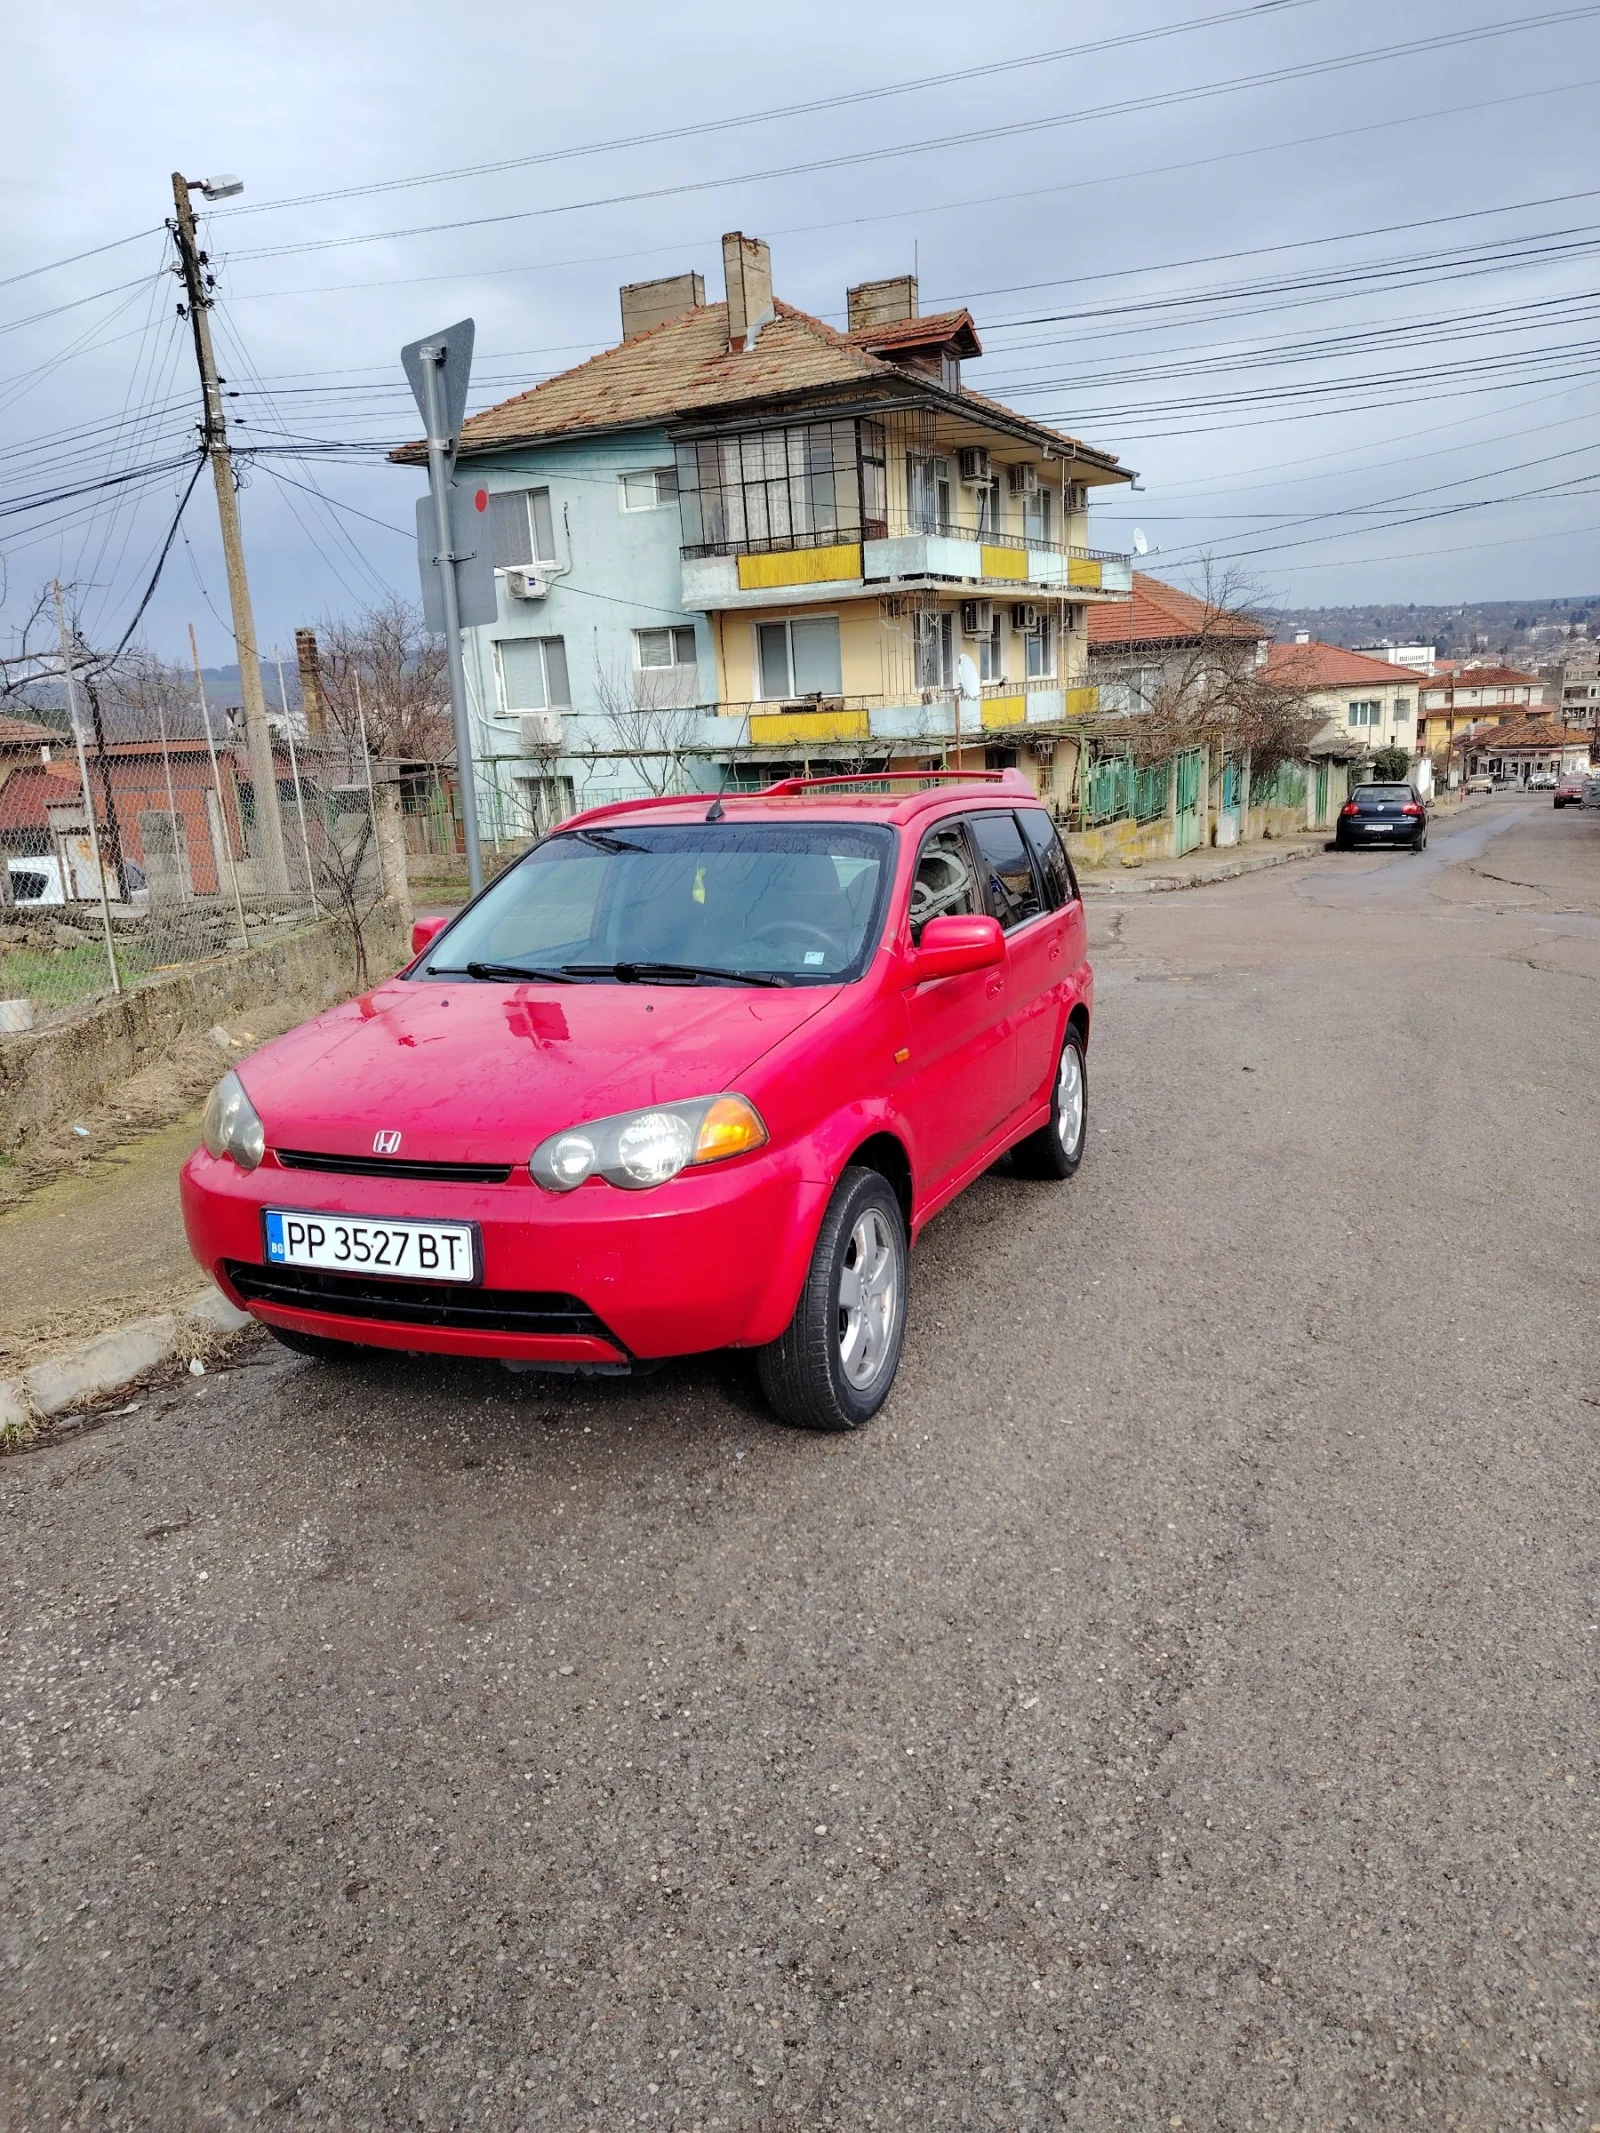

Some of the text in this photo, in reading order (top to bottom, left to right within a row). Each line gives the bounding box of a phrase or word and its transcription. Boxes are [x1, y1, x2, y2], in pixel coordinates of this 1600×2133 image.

[271, 1242, 284, 1254] BG
[287, 1222, 461, 1271] PP 3527 BT
